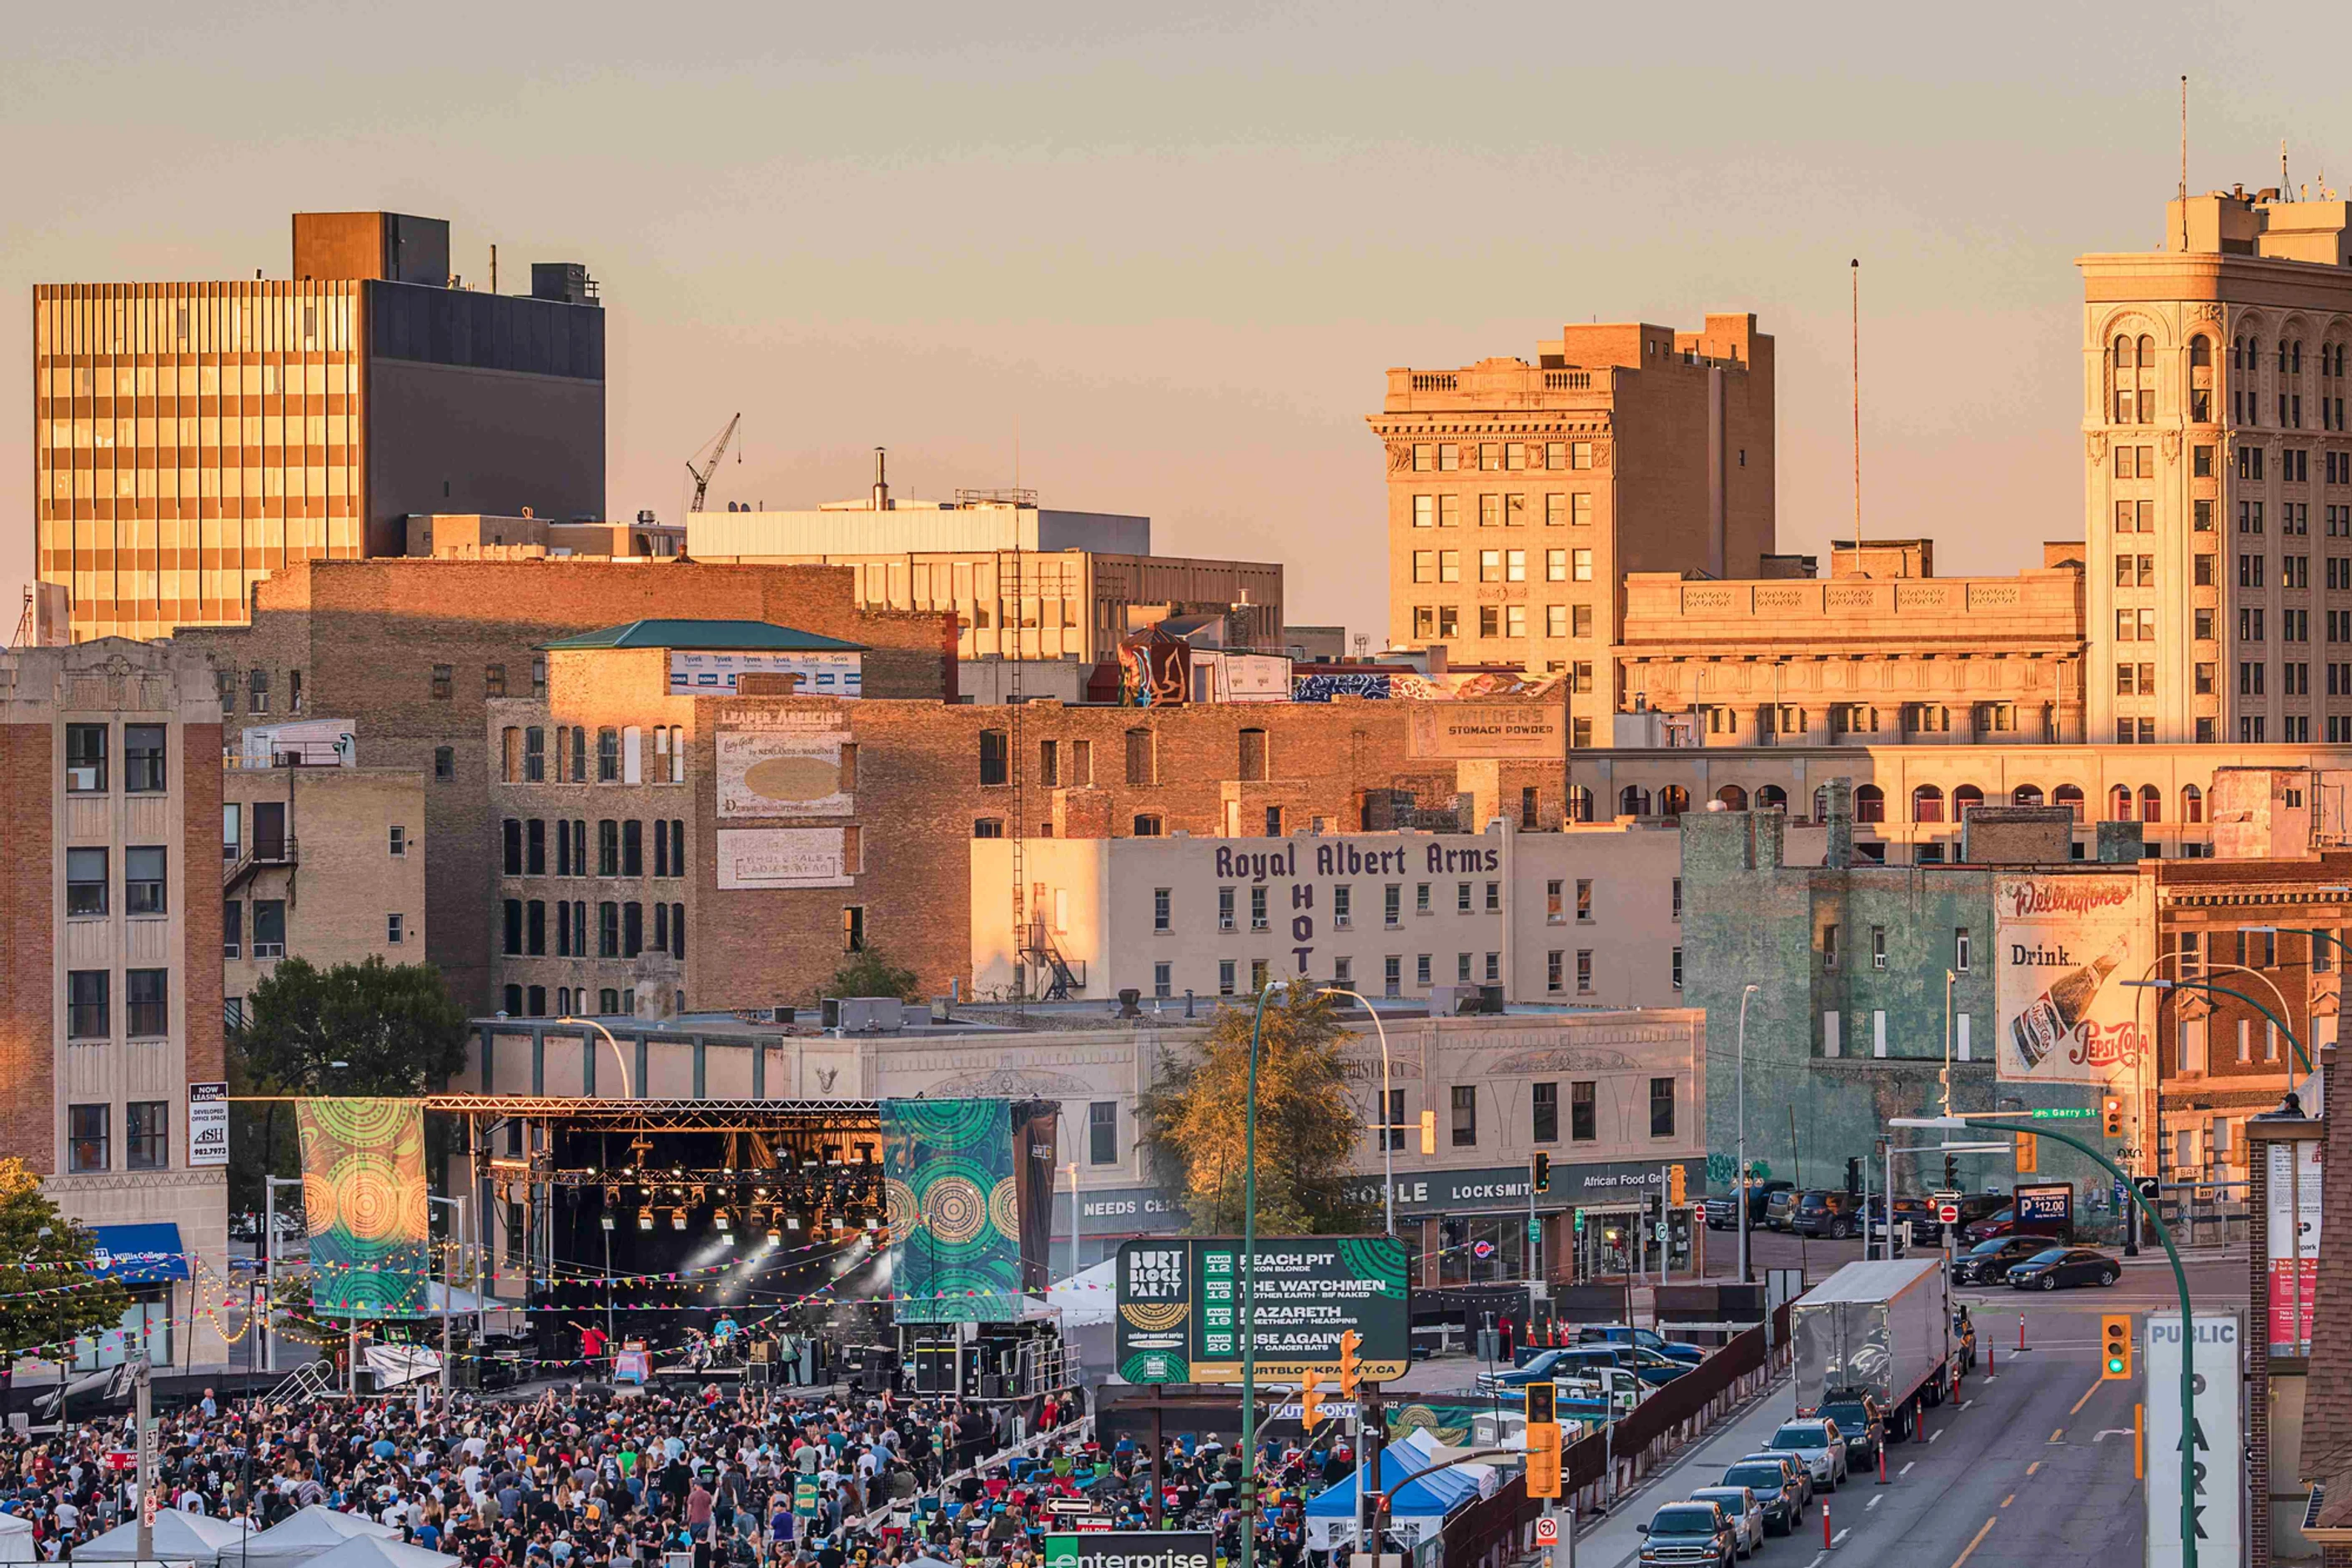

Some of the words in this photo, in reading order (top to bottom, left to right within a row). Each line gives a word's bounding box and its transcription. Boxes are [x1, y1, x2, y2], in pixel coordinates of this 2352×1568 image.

[772, 656, 791, 664] Tyvek
[1449, 726, 1501, 735] STOMACH
[1505, 725, 1554, 734] POWDER
[1215, 842, 1296, 883] Royal
[1316, 841, 1406, 876] Albert
[1426, 842, 1499, 874] Arms
[1348, 1059, 1405, 1080] DISTRCT
[2052, 1108, 2080, 1118] Garry
[195, 1128, 224, 1142] ASH
[193, 1147, 226, 1156] 982.7973
[2180, 1168, 2199, 1177] BAR
[1584, 1175, 1617, 1187] African
[1621, 1173, 1645, 1185] Food
[1084, 1201, 1137, 1216] NEEDS
[2035, 1200, 2065, 1212] $12.00
[113, 1252, 138, 1261] Willis
[138, 1251, 168, 1262] College
[1129, 1250, 1184, 1269] BURT
[1306, 1254, 1334, 1265] PIT
[1207, 1264, 1231, 1273] 12
[1129, 1268, 1183, 1283] BLOCK
[1129, 1282, 1183, 1297] PARTY
[1239, 1280, 1274, 1292] THE
[1279, 1279, 1386, 1291] WATCHMEN
[1207, 1317, 1231, 1325] 19
[1128, 1331, 1148, 1339] outdoor
[1283, 1333, 1364, 1344] AGAINT
[2152, 1324, 2234, 1344] PULIC
[1207, 1344, 1231, 1352] 20
[148, 1431, 158, 1446] 57
[1055, 1549, 1209, 1568] enterprise
